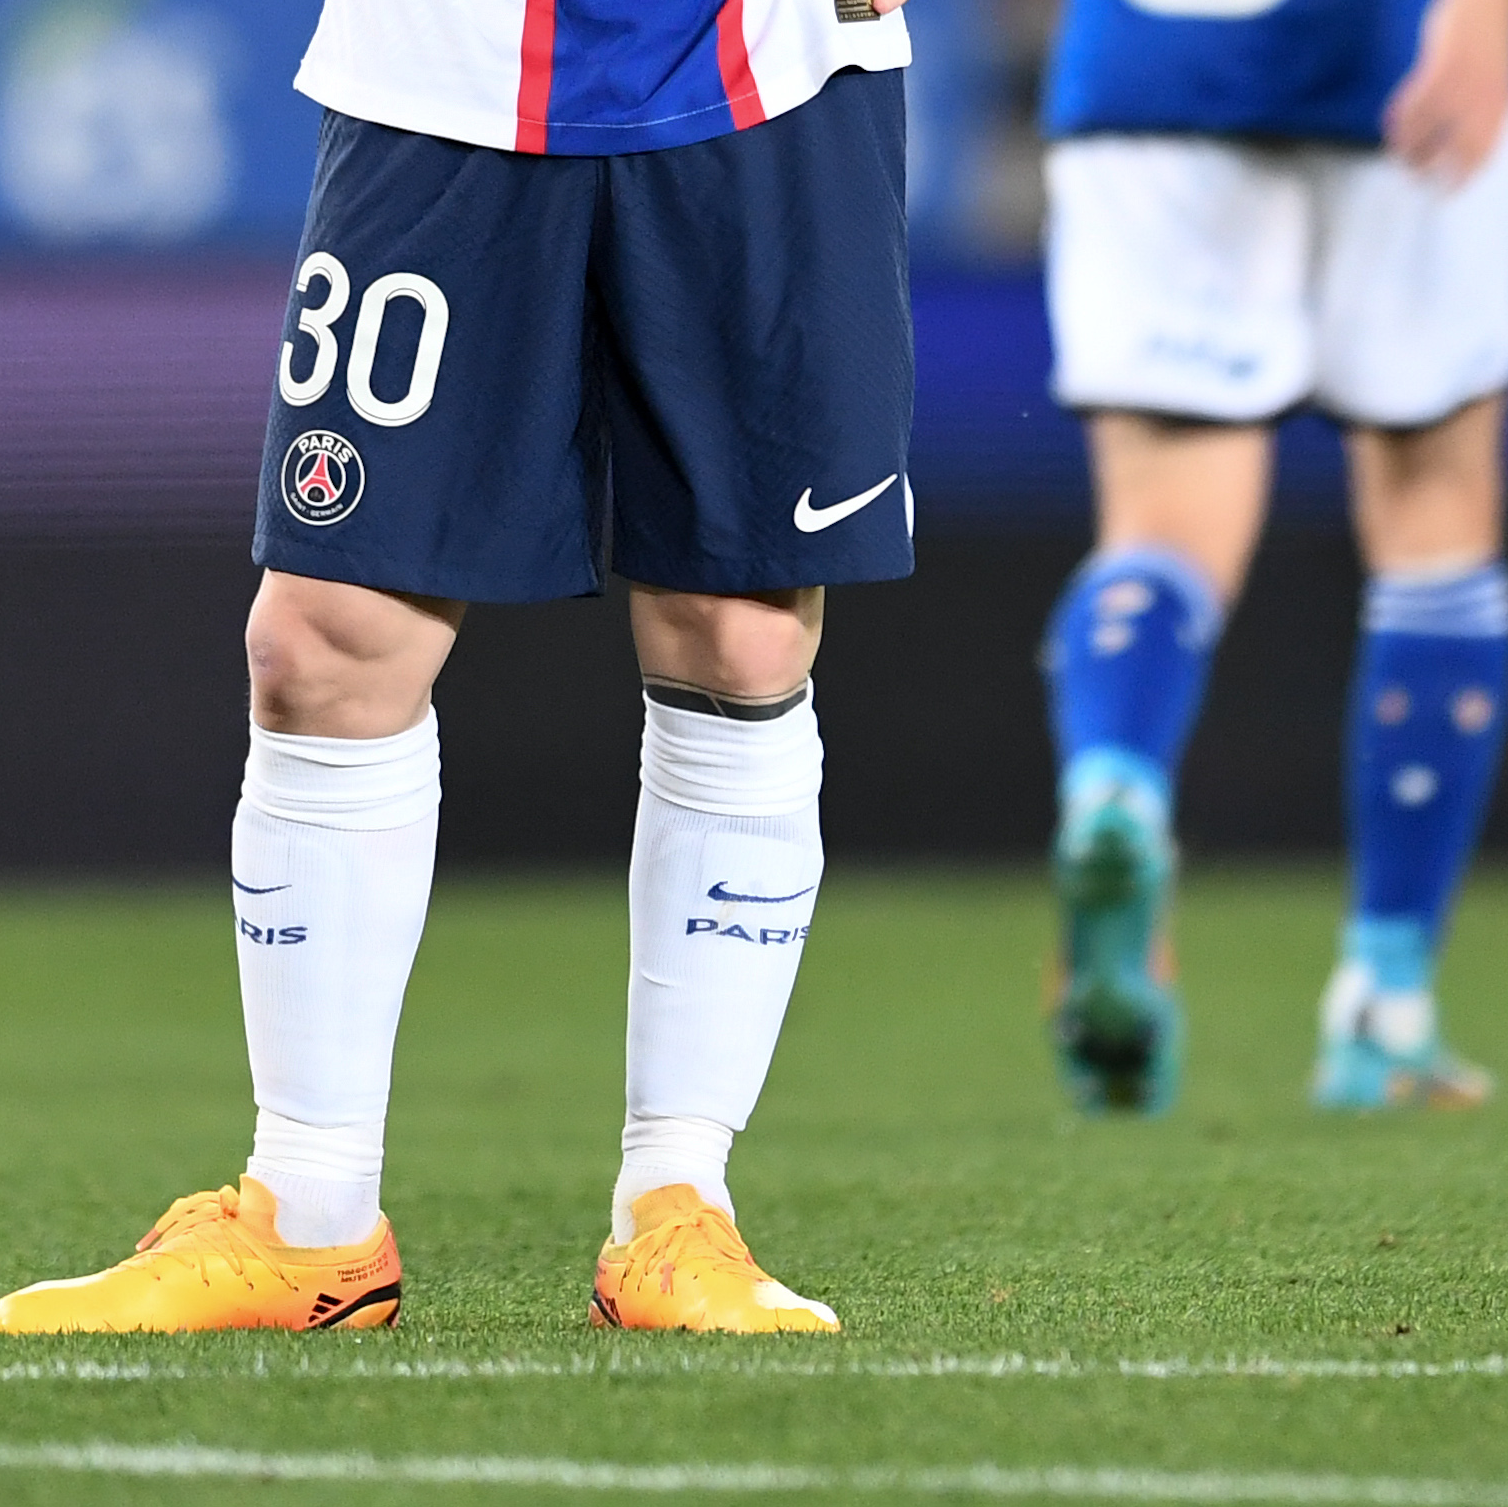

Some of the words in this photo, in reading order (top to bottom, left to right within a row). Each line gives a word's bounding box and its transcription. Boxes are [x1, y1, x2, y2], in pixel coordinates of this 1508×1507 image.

[279, 251, 450, 428] 30
[297, 435, 353, 465] PARIS
[236, 916, 309, 946] RIS
[685, 917, 811, 946] PARIS
